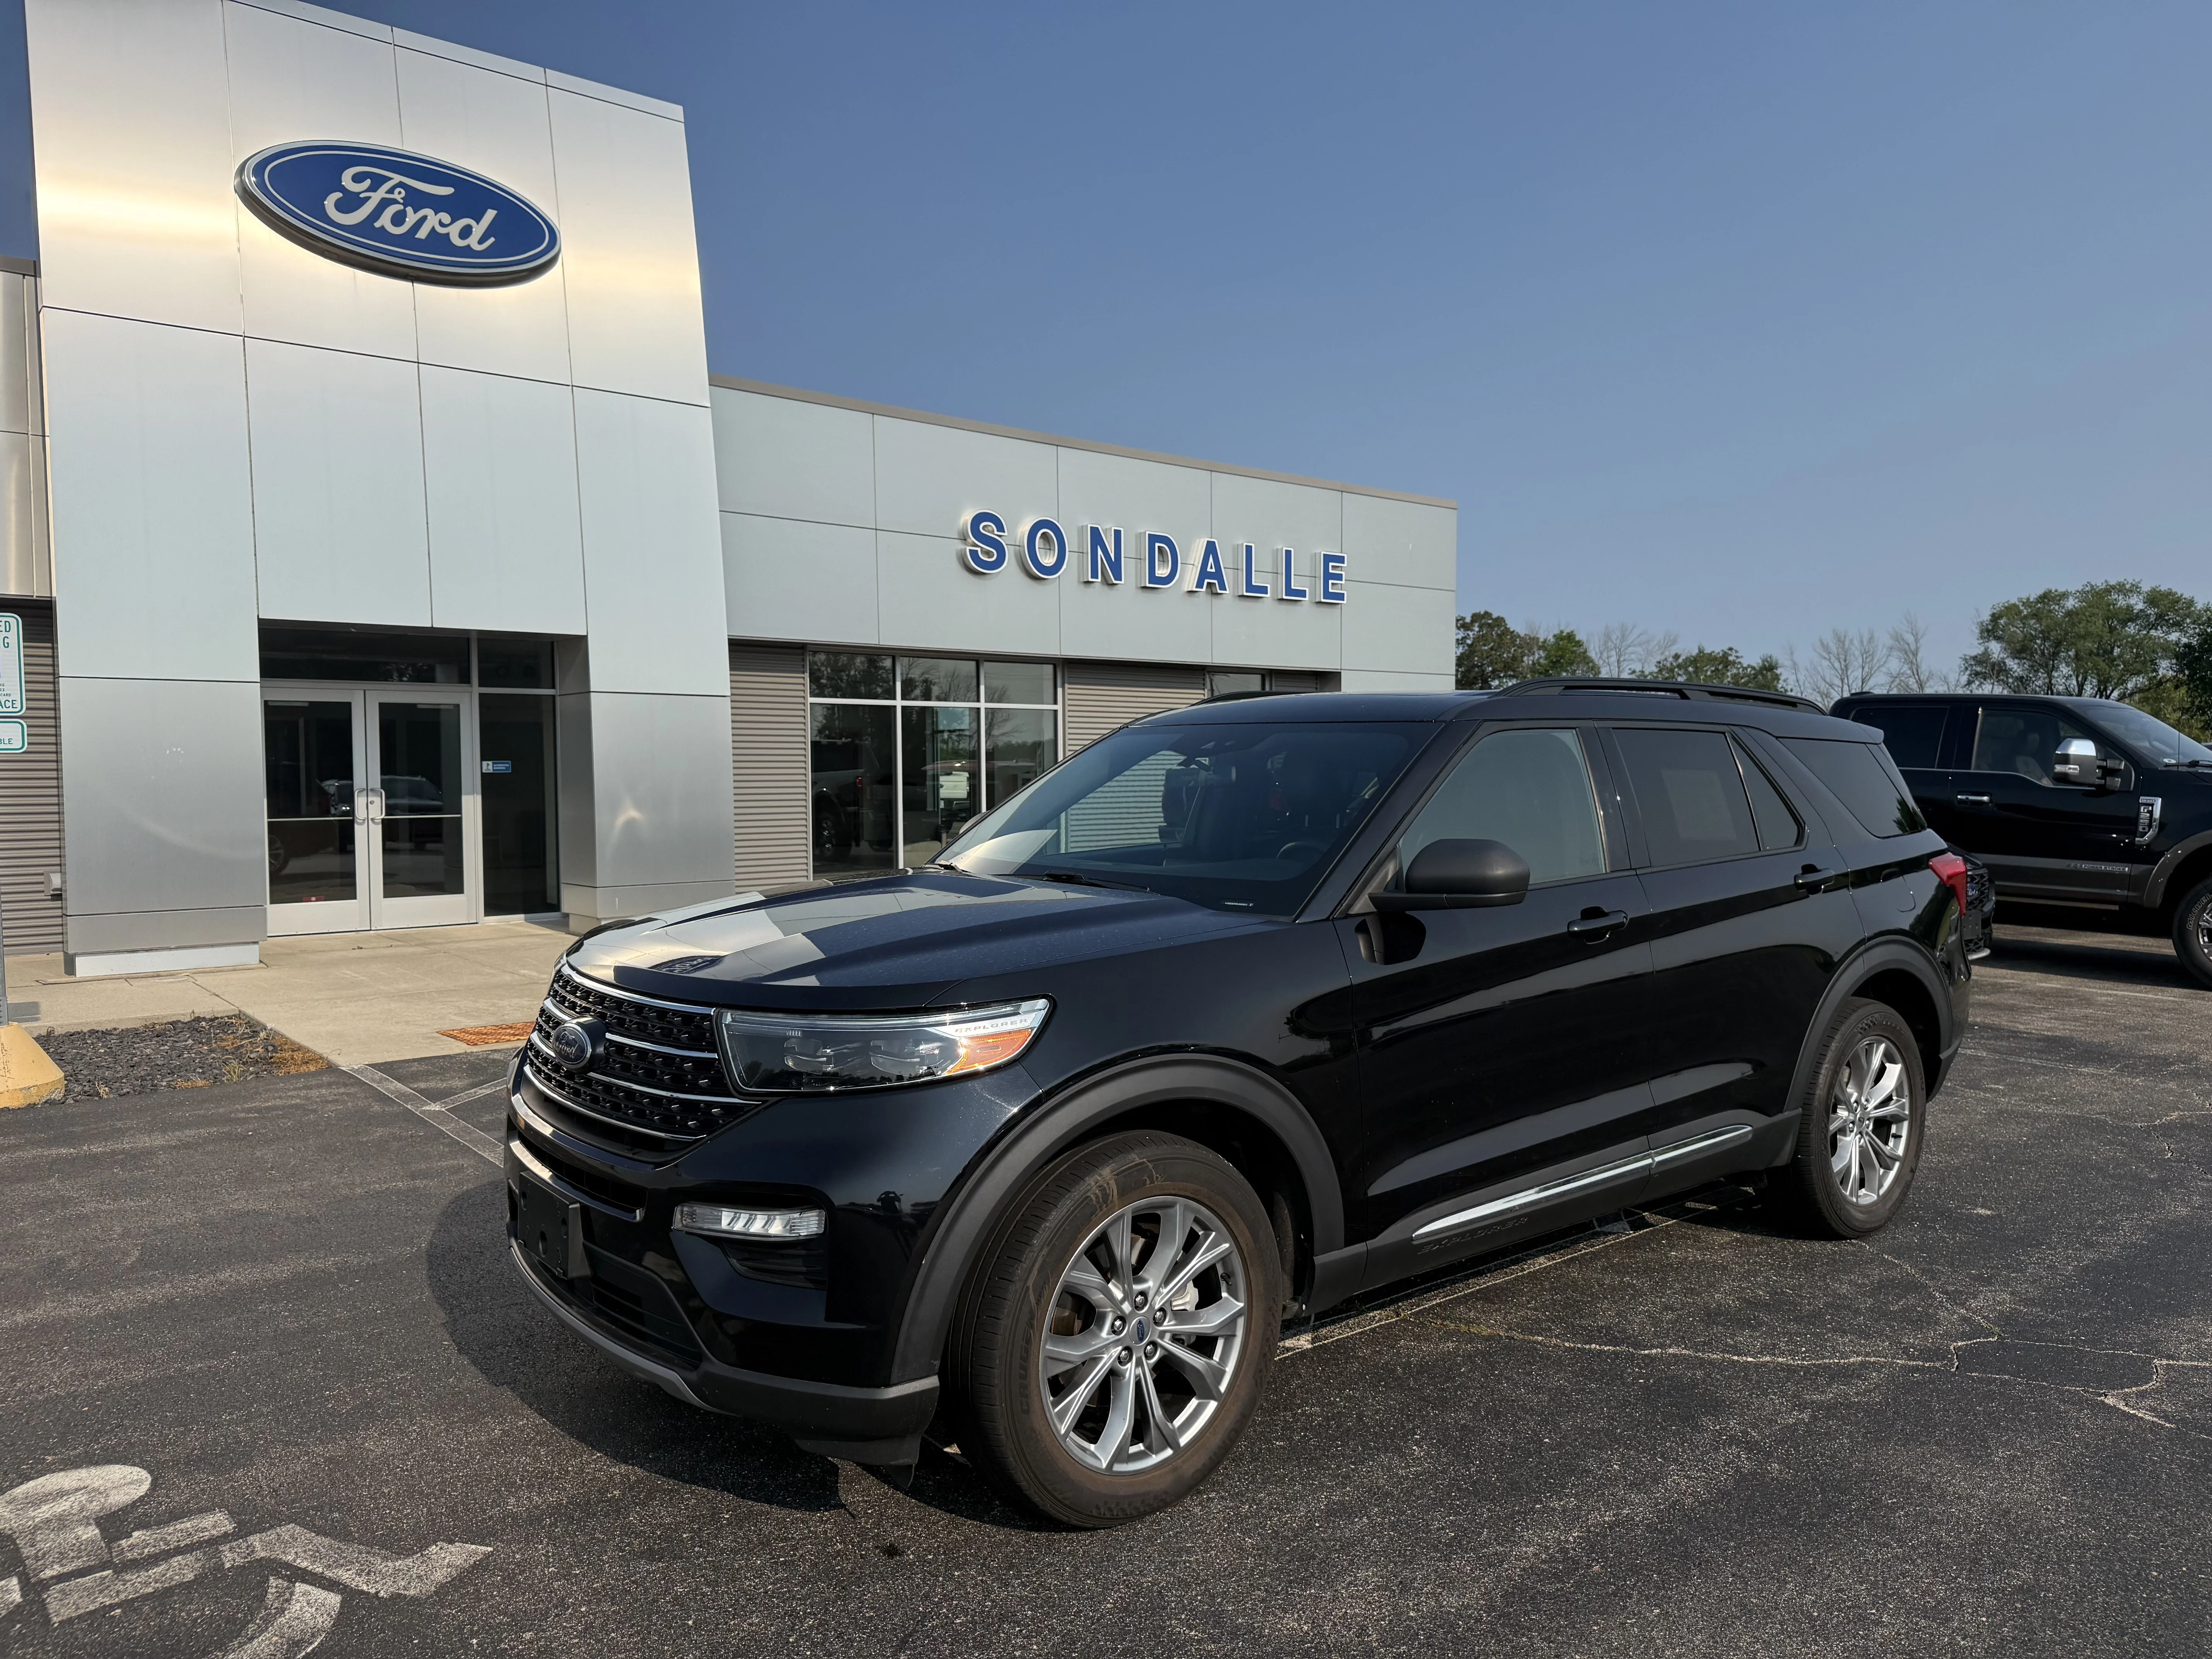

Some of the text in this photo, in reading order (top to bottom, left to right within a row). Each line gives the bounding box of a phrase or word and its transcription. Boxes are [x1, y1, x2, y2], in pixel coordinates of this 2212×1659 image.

[324, 166, 498, 251] Ford
[965, 509, 1347, 604] SONDALLE
[554, 1030, 579, 1059] Ford
[955, 1018, 1027, 1033] EXPLORER
[1417, 1217, 1528, 1255] EXPLORER
